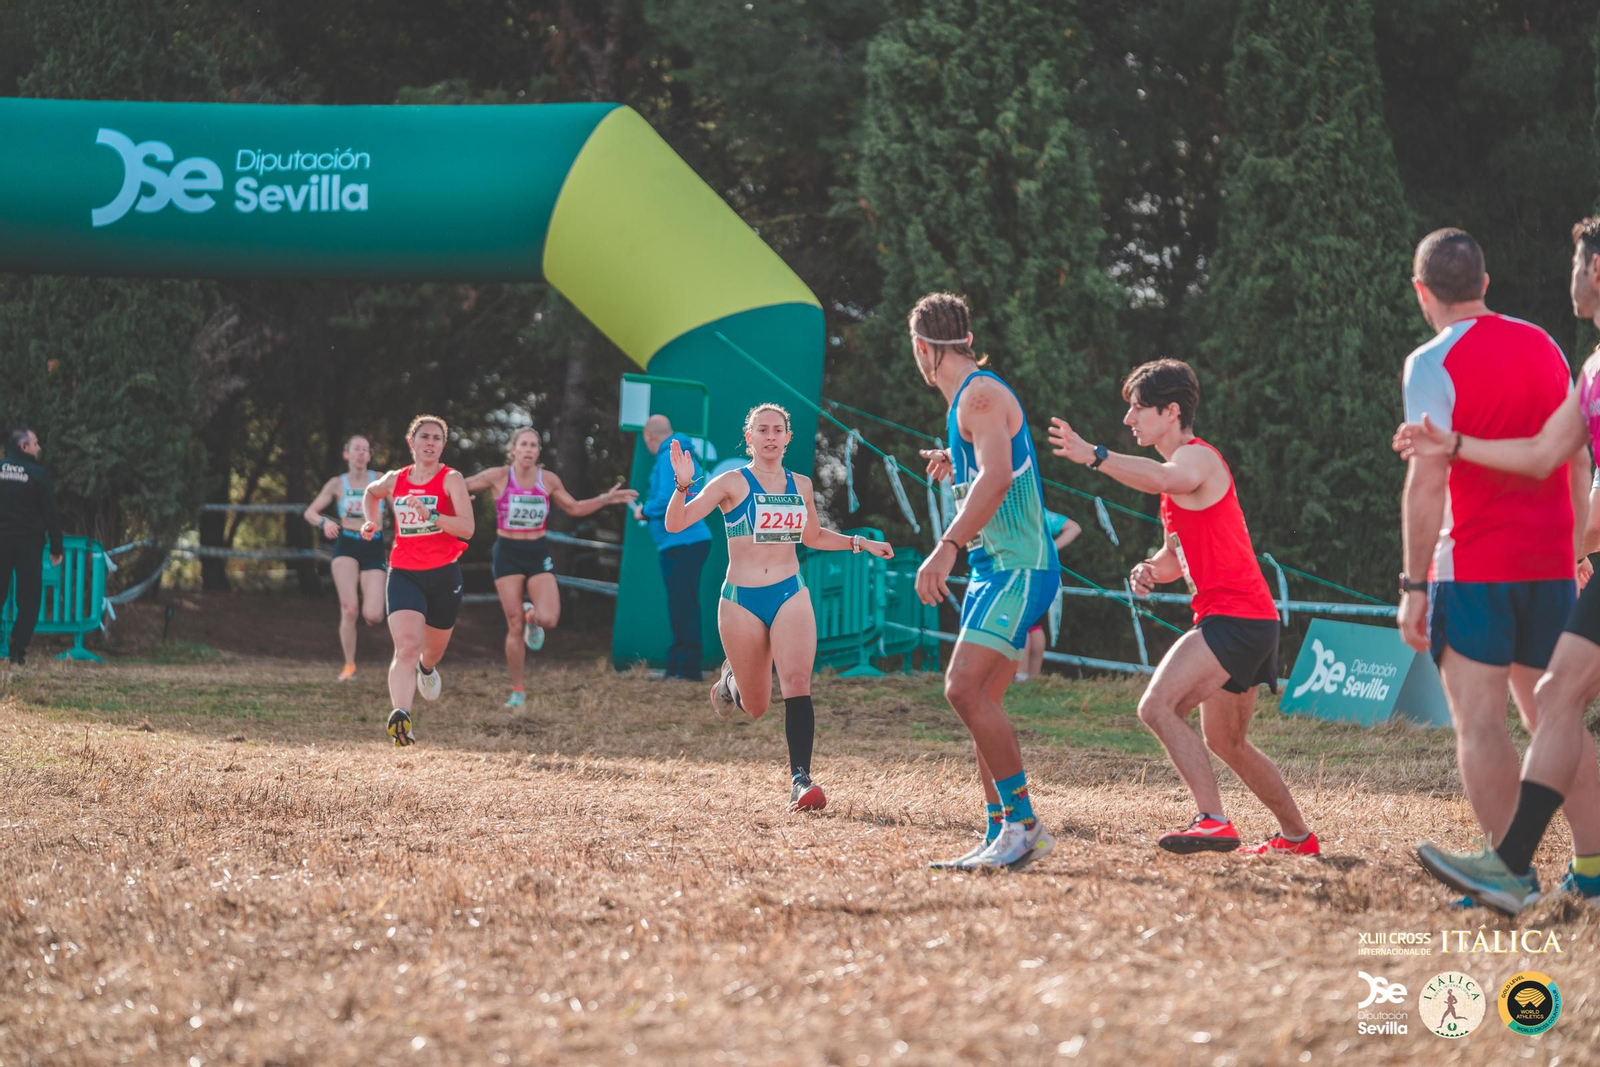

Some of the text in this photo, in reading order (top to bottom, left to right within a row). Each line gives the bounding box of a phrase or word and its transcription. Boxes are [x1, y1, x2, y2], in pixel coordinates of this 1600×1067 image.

[235, 148, 370, 175] Diputación
[235, 175, 369, 213] Sevilla
[513, 508, 544, 519] 2204
[760, 512, 803, 529] 2241
[1350, 659, 1397, 677] Diputación
[1342, 675, 1390, 701] Sevilla
